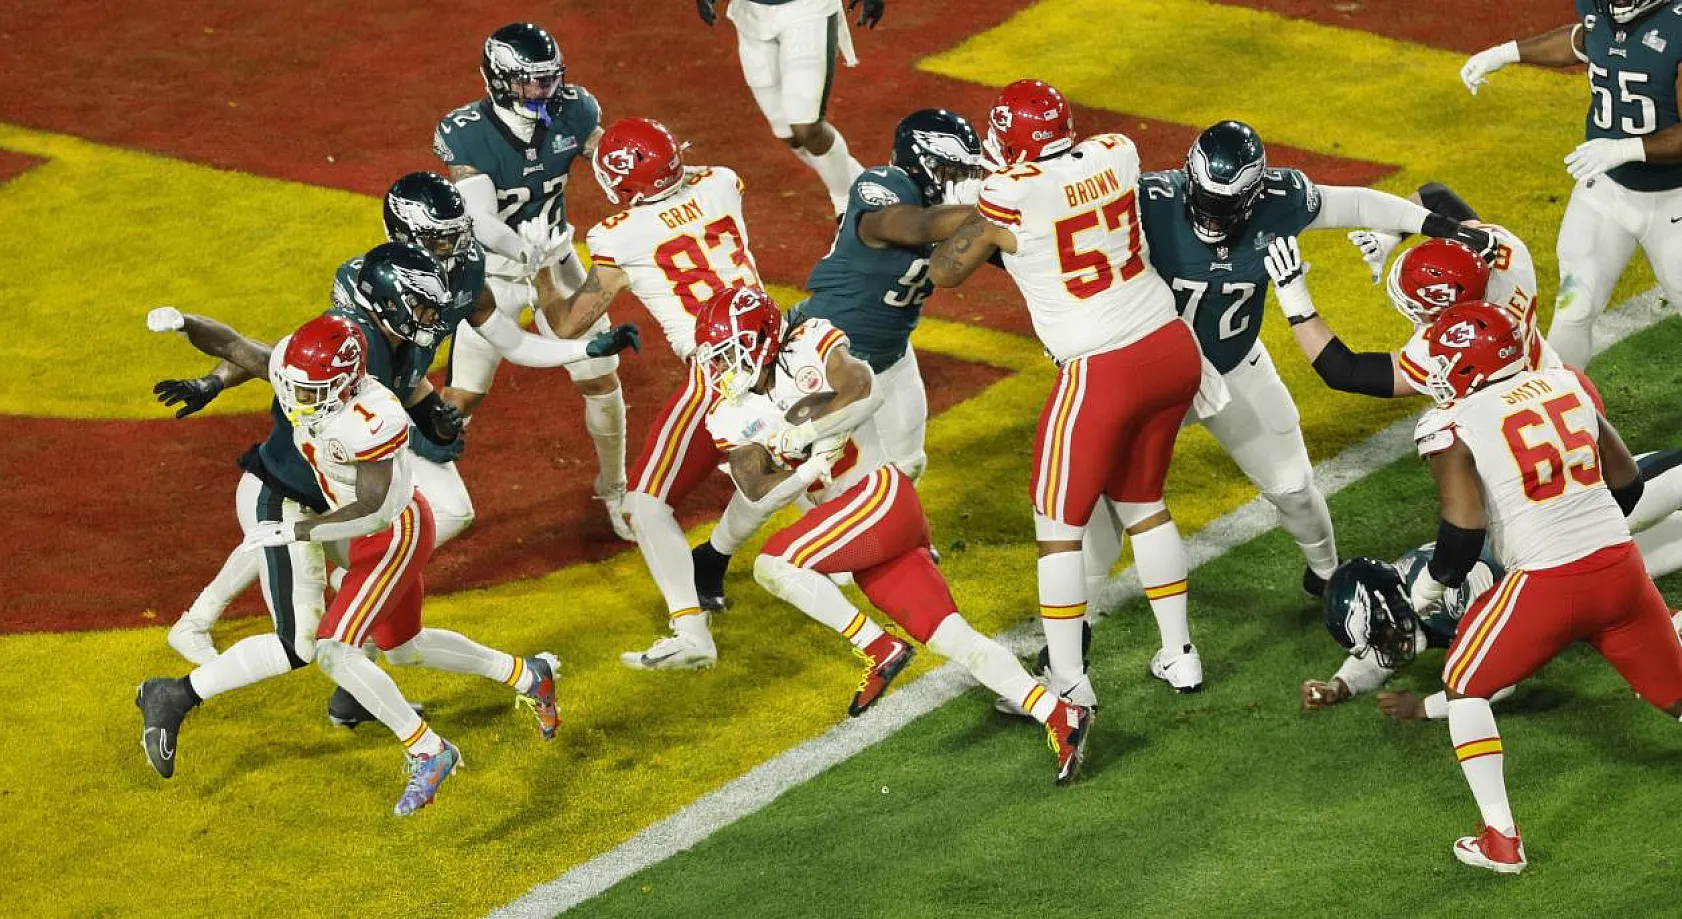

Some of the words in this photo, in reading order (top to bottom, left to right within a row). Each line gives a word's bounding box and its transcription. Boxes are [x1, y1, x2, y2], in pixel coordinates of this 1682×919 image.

[1588, 62, 1656, 135] 55
[658, 198, 703, 229] GRAY
[1063, 168, 1121, 208] BROWN
[1054, 188, 1146, 300] 57
[1172, 277, 1257, 342] 72
[1501, 378, 1553, 405] SMITH
[1502, 392, 1602, 502] 65
